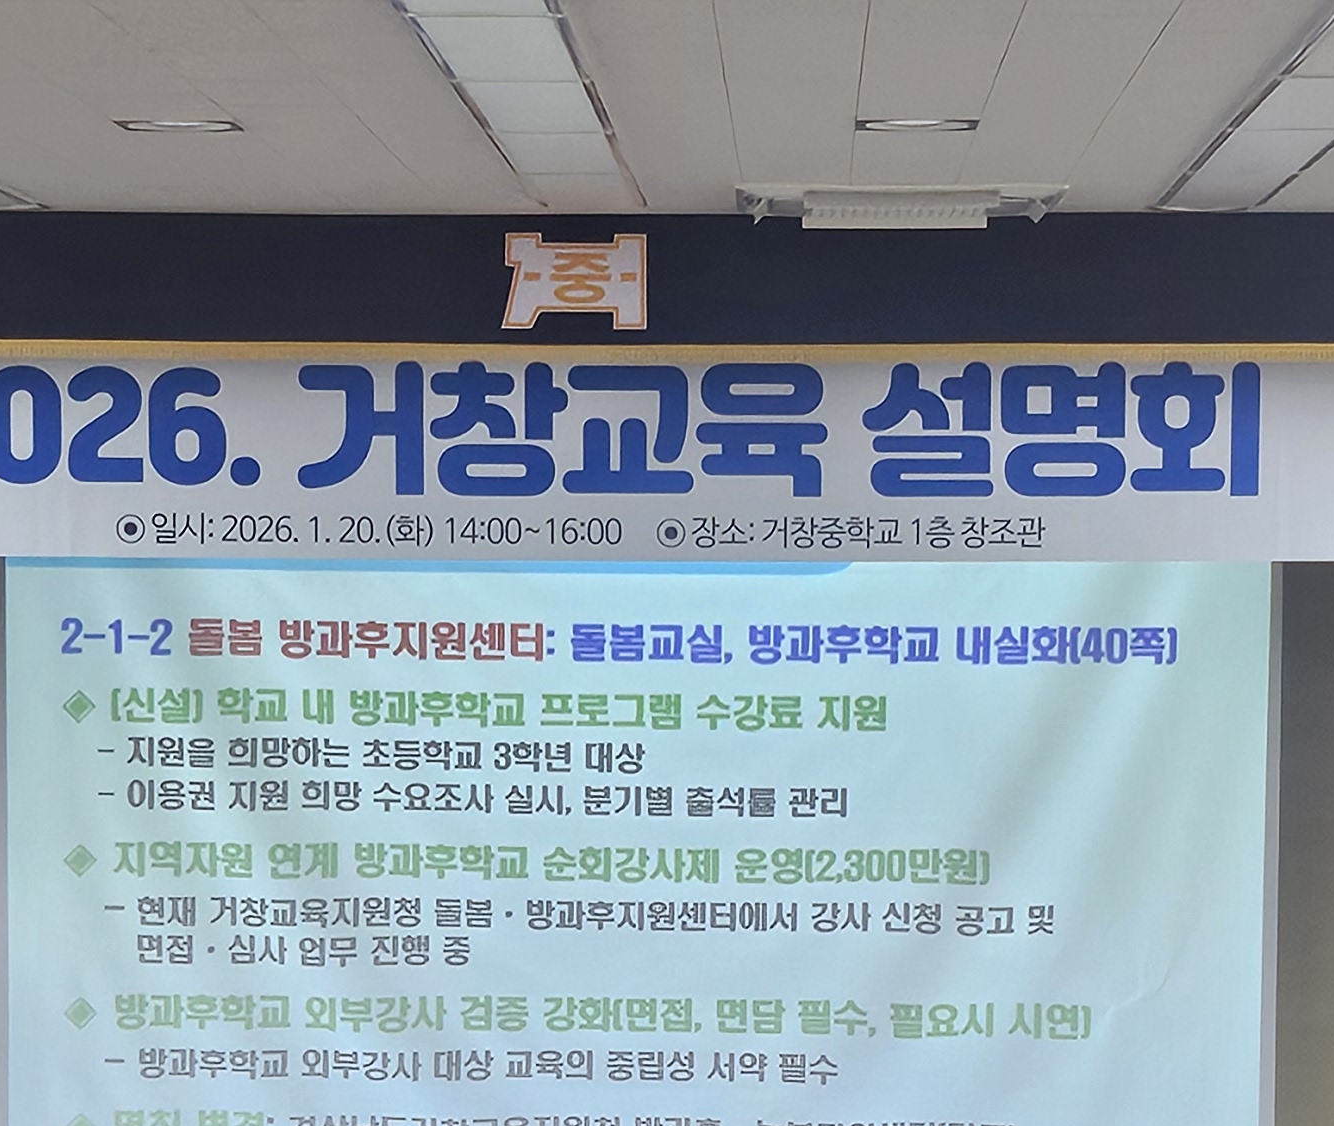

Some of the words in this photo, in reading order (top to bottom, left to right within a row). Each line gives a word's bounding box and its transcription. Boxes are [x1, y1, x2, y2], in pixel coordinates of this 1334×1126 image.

[549, 251, 612, 304] 중
[296, 362, 831, 498] 거창교육
[863, 360, 1262, 497] 설명회
[152, 513, 213, 544] 일시:
[222, 515, 298, 542] 2026.
[446, 518, 621, 545] 14:00~16:00
[692, 516, 754, 548] 장소:
[762, 517, 902, 549] 거창중학교
[912, 516, 955, 548] 1층
[961, 517, 1045, 548] 창조관
[61, 618, 172, 655] 2-1-2
[189, 619, 262, 656] 돌봄
[280, 620, 555, 661] 방과후지원센터:
[571, 624, 732, 664] 돌봄교실,
[749, 625, 939, 665] 방과후학교
[957, 626, 1177, 664] 내실화(40쪽)
[218, 687, 287, 724] 학교
[303, 689, 334, 724] 내
[350, 690, 525, 728] 방과후학교
[541, 694, 681, 730] 프로그램
[697, 695, 803, 732] 수강료
[817, 695, 886, 731] 지원
[127, 737, 215, 768] 지원을
[228, 737, 349, 768] 희망하는
[363, 739, 481, 770] 초등학교
[494, 742, 571, 772] 3학년
[586, 743, 645, 774] 대상
[128, 780, 215, 810] 이용권
[229, 780, 288, 811] 지원
[302, 780, 362, 811] 희망
[374, 783, 494, 813] 수요조사
[505, 785, 571, 815] 실시,
[584, 786, 672, 816] 분기별
[686, 787, 776, 817] 출석률
[789, 788, 847, 817] 관리
[114, 840, 255, 880] 지역자원
[268, 842, 338, 879] 연계
[355, 843, 529, 880] 방과후학교
[543, 846, 719, 883] 순회강사제
[138, 896, 196, 926] 현재
[210, 897, 421, 928] 거창교육지원청
[435, 899, 492, 928] 돌봄
[812, 902, 871, 932] 강사
[882, 903, 941, 934] 신청
[956, 906, 1014, 936] 공고
[1028, 905, 1054, 934] 및
[138, 935, 193, 964] 면접
[228, 935, 287, 965] 심사
[299, 937, 357, 967] 업무
[371, 935, 429, 965] 진행
[443, 937, 470, 965] 중
[115, 993, 291, 1032] 방과후학교
[305, 996, 447, 1033] 외부강사
[461, 995, 530, 1031] 검증
[717, 999, 786, 1036] 면담
[797, 1000, 876, 1038] 필수,
[890, 1003, 994, 1039] 필요시
[1008, 1003, 1091, 1041] 시연)
[139, 1048, 288, 1080] 방과후학교
[302, 1050, 422, 1082] 외부강사
[434, 1050, 494, 1081] 대상
[506, 1050, 593, 1080] 교육의
[607, 1051, 694, 1081] 중립성
[707, 1052, 767, 1082] 서약
[779, 1054, 838, 1085] 필수
